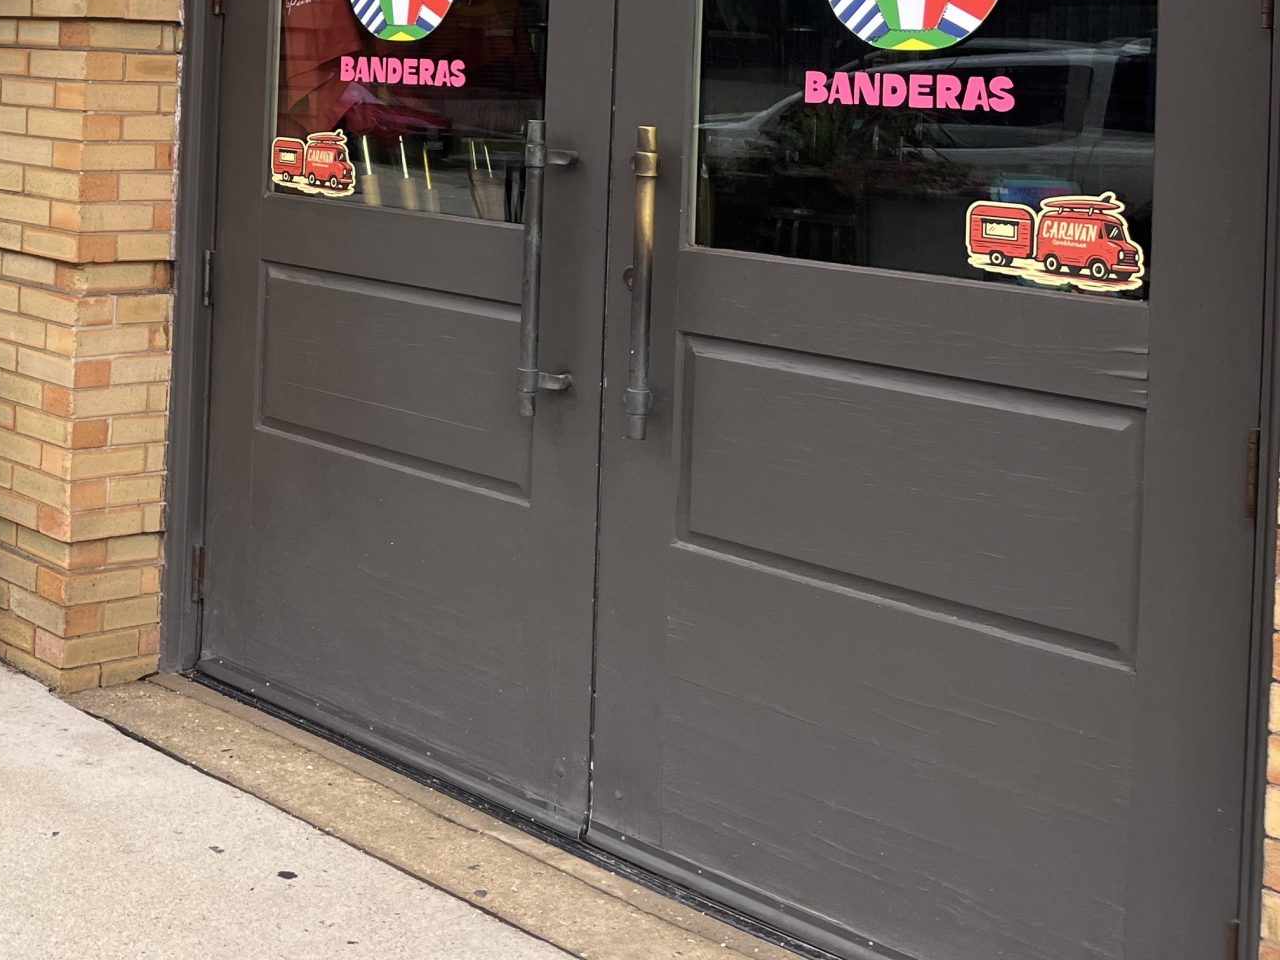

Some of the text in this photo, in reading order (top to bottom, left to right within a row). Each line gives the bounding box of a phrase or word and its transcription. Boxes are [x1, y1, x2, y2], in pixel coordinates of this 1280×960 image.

[340, 56, 466, 87] BANDERAS
[805, 70, 1015, 112] BANDERAS
[1042, 220, 1098, 243] CARAVAN
